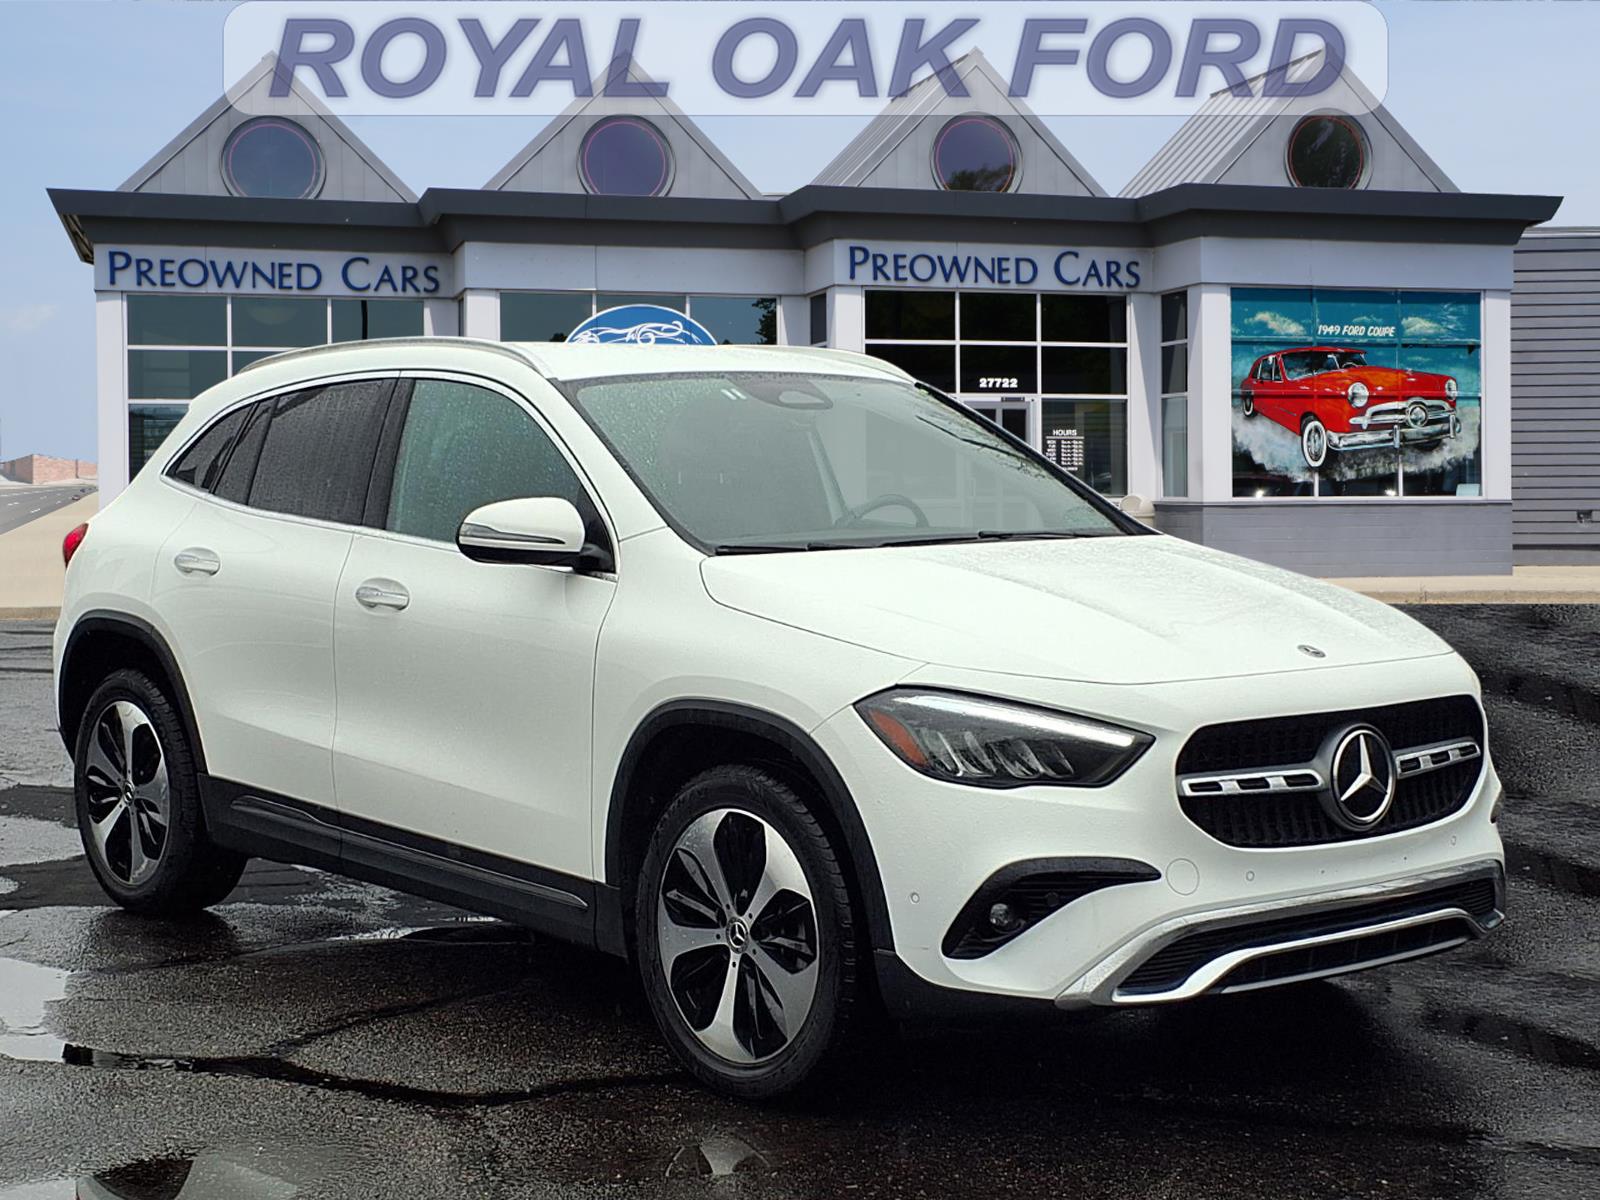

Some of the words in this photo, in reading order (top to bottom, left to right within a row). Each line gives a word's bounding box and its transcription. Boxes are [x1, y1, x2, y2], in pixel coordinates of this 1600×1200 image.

[108, 251, 322, 290] PREOWNED
[342, 257, 440, 293] CARS
[849, 246, 1038, 285] PREOWNED
[1054, 251, 1141, 289] CARS
[1318, 324, 1340, 335] 1949
[1342, 326, 1365, 336] FORD
[1367, 327, 1395, 337] COUPE
[979, 377, 1018, 388] 27722
